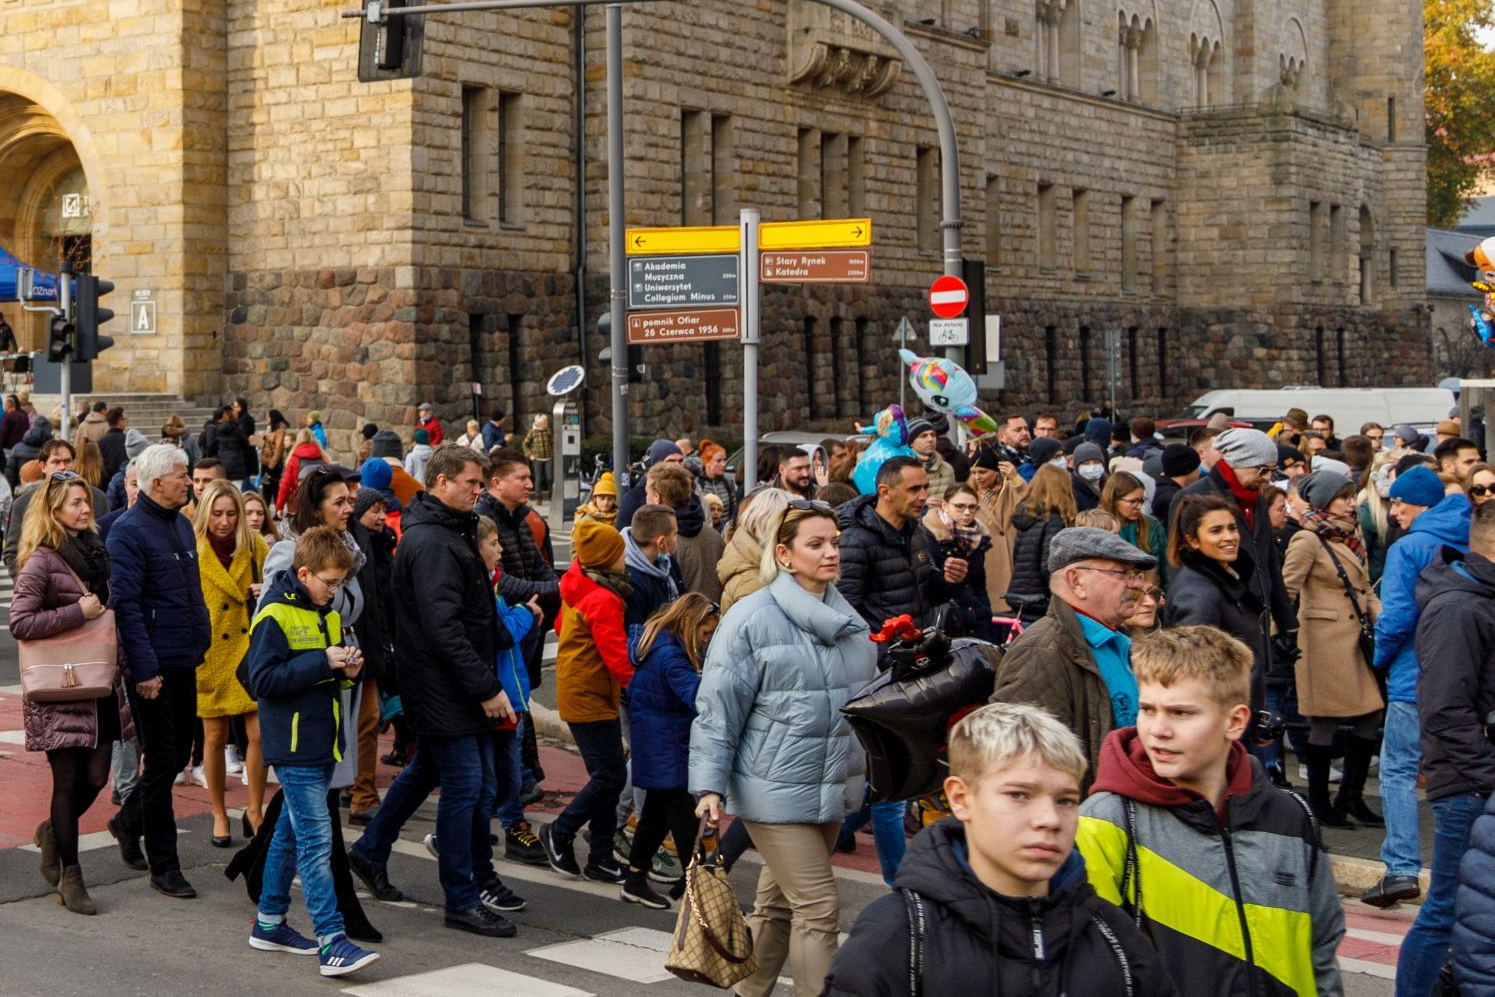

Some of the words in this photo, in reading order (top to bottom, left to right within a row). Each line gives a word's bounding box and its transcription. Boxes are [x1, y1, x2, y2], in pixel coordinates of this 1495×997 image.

[644, 262, 686, 271] Akademia
[776, 256, 797, 267] Stary
[801, 256, 826, 267] Rynek
[775, 267, 809, 276] Katedra
[644, 273, 685, 282] Muzyczna
[644, 283, 692, 292] Uniwersytet
[644, 293, 687, 303] Collegium
[690, 292, 716, 301] Minus
[137, 305, 149, 330] A
[642, 317, 674, 328] pomnik
[677, 316, 700, 325] Ofiar
[644, 328, 656, 337] 28
[659, 327, 695, 336] Czerwca
[698, 325, 718, 334] 1956
